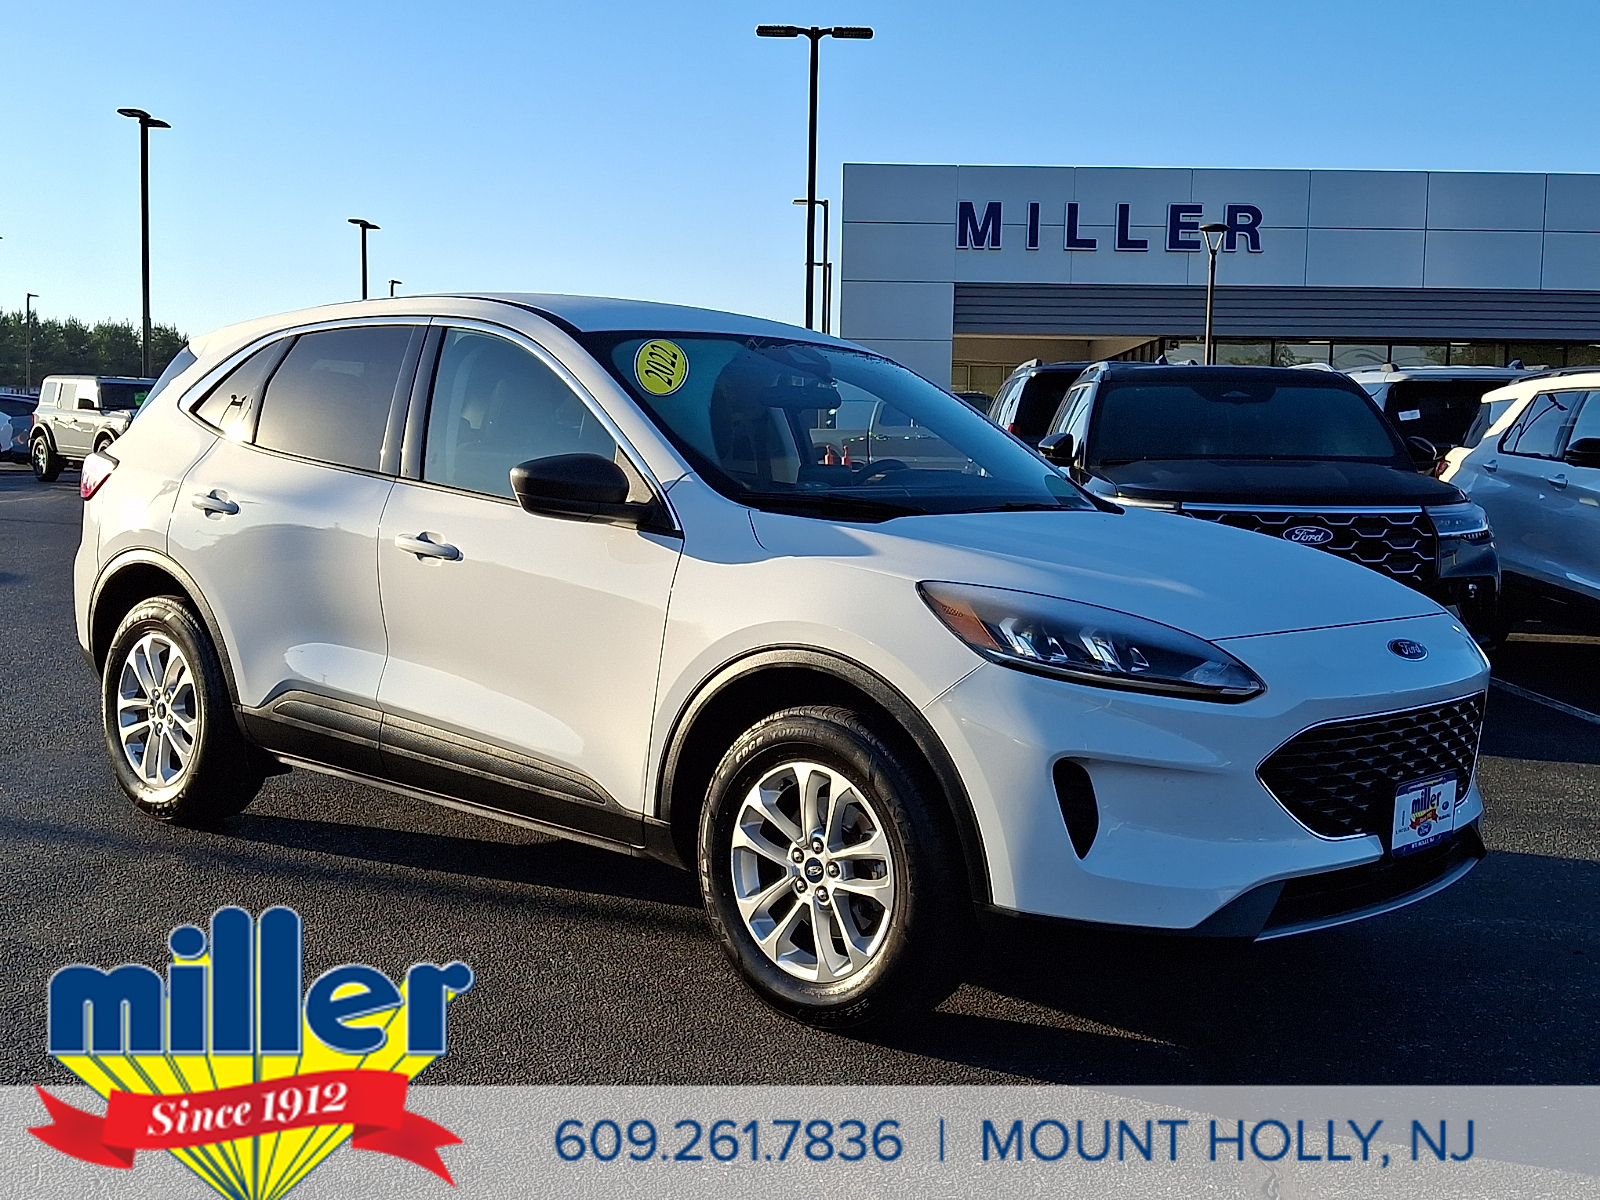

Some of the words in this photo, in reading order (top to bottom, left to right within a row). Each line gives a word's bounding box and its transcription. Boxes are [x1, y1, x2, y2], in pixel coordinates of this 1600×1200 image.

[956, 201, 1263, 252] MILLER
[644, 344, 678, 388] 2022
[1291, 528, 1325, 542] Ford
[1397, 641, 1422, 655] Ford
[1411, 786, 1442, 814] miller
